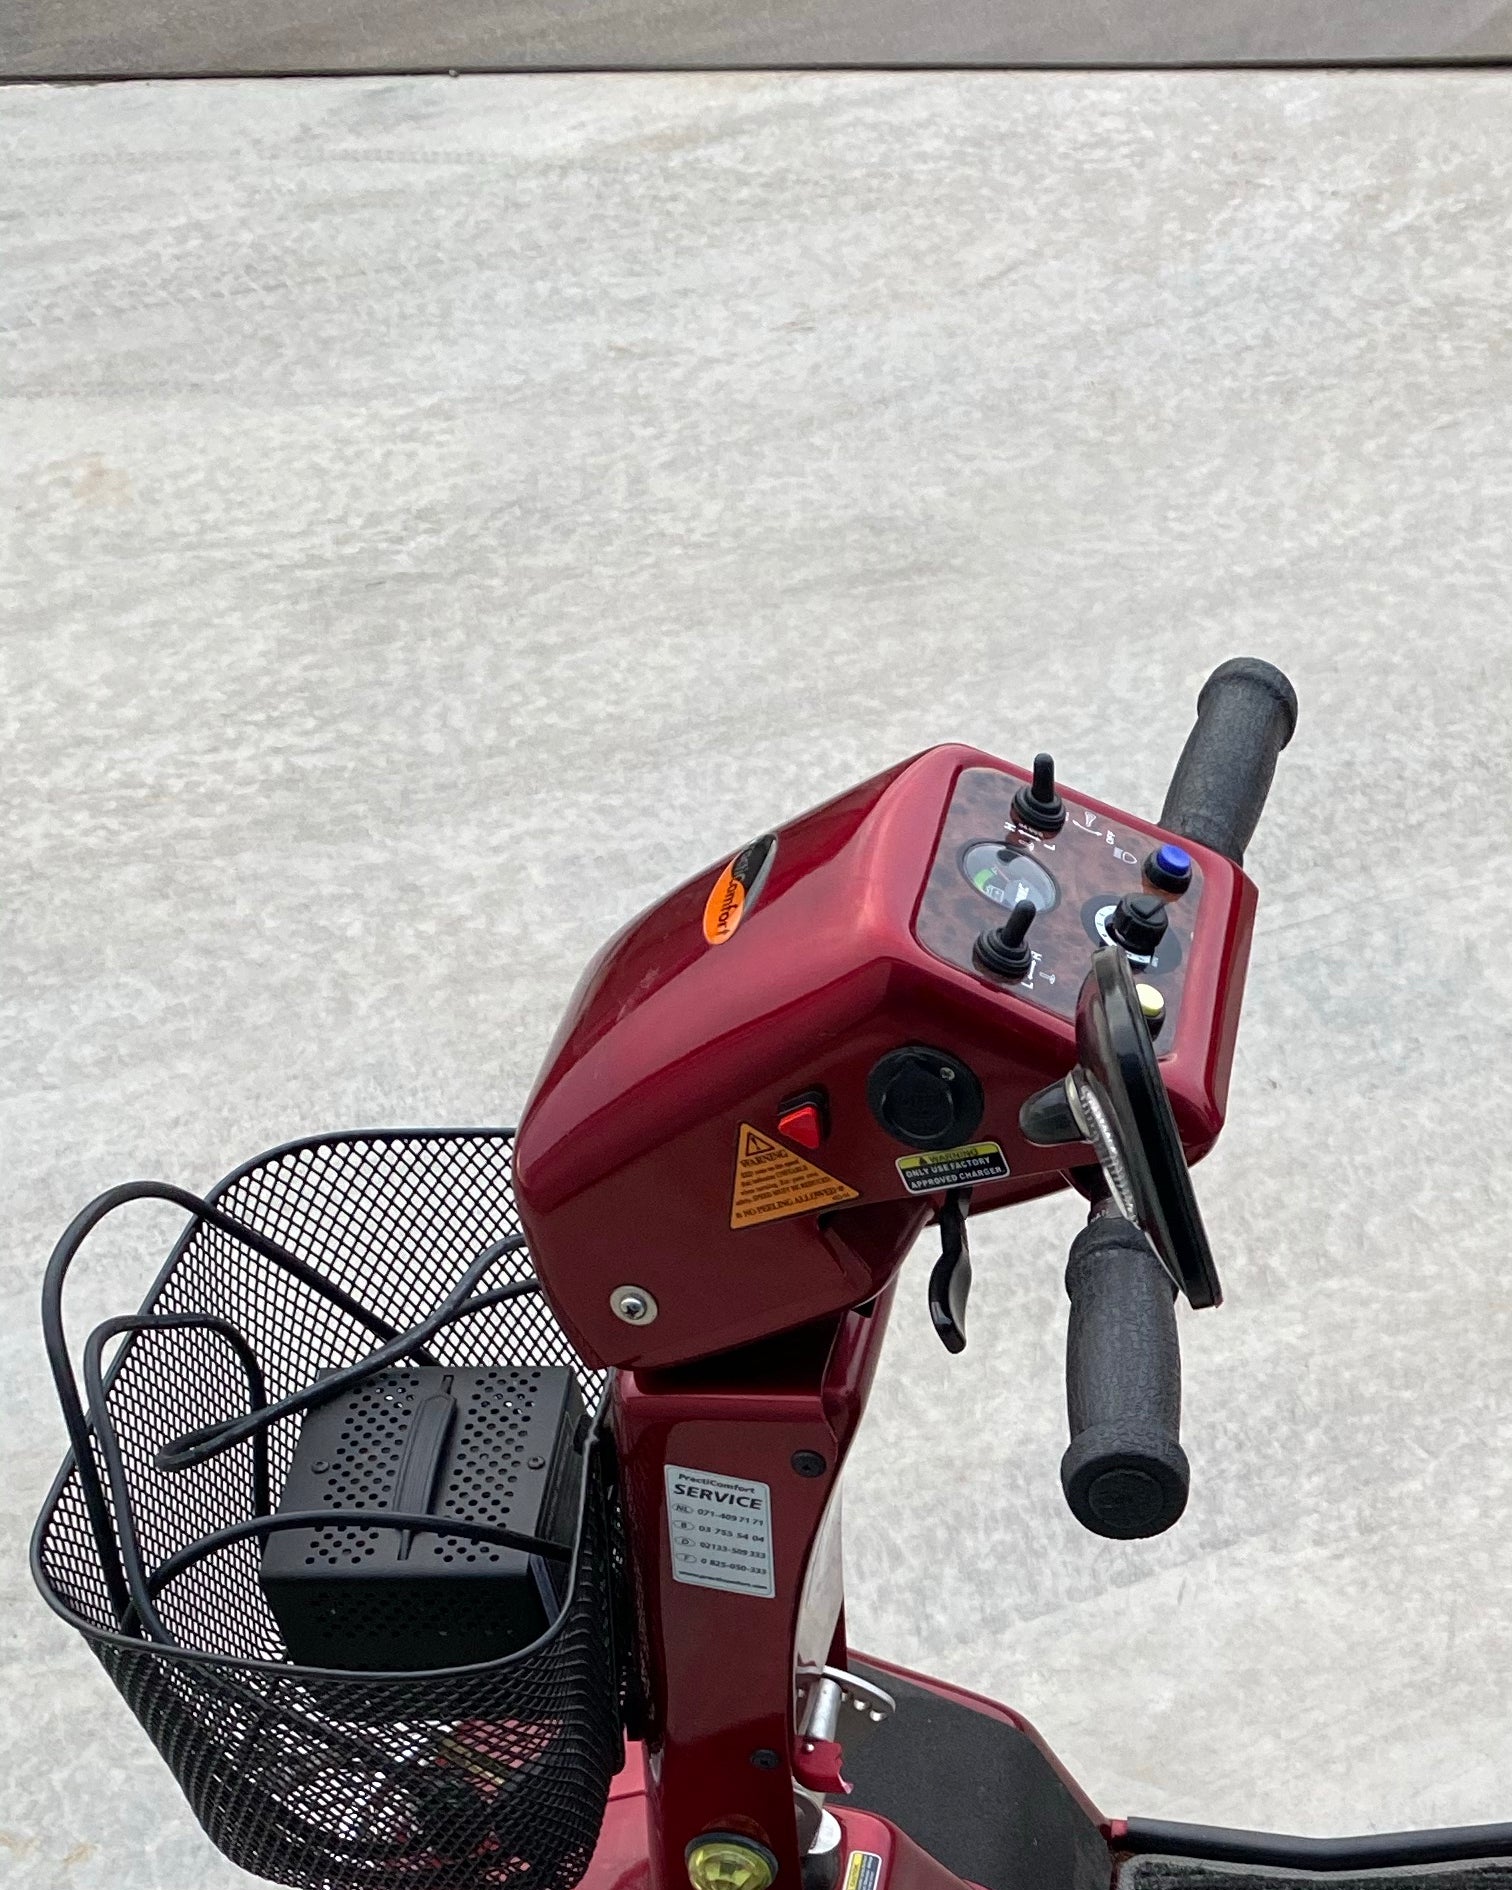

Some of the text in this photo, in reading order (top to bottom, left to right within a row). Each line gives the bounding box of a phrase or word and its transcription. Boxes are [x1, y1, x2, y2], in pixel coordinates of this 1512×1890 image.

[740, 1150, 789, 1168] WARNING
[928, 1147, 978, 1164] WARNING
[905, 1156, 991, 1178] ONLY USE FACTORY
[911, 1174, 958, 1189] APPROVED
[743, 1207, 758, 1217] NO
[759, 1197, 794, 1214] PEELING
[794, 1187, 837, 1203] ALLOWED
[679, 1474, 755, 1494] PractiComfort
[673, 1484, 763, 1510] SERVICE
